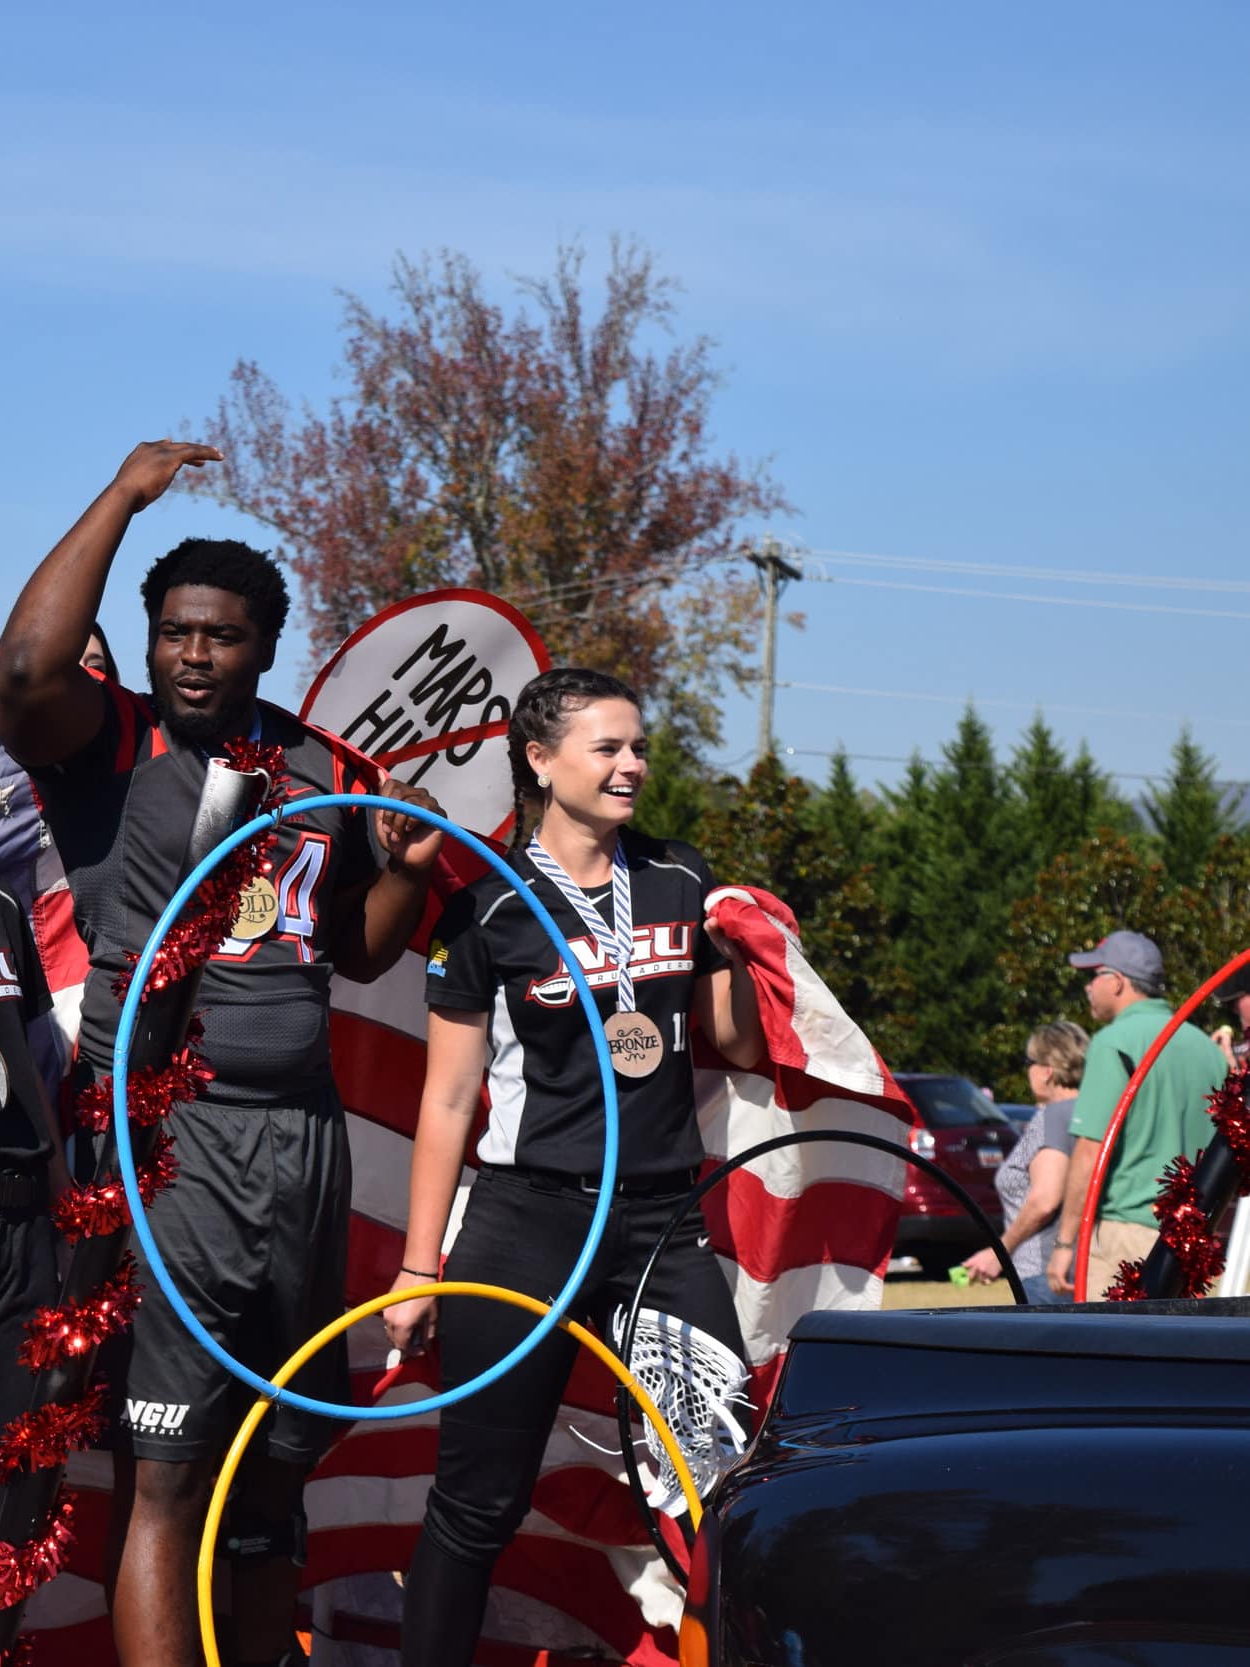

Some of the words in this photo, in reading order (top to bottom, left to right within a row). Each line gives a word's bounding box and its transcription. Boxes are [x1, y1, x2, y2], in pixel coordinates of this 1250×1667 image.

[391, 624, 511, 767] MARS
[238, 893, 276, 914] OLD
[586, 962, 692, 984] RUADERS
[607, 1035, 660, 1054] BRONZE
[120, 1398, 191, 1429] NGU
[121, 1420, 183, 1436] OTBALL
